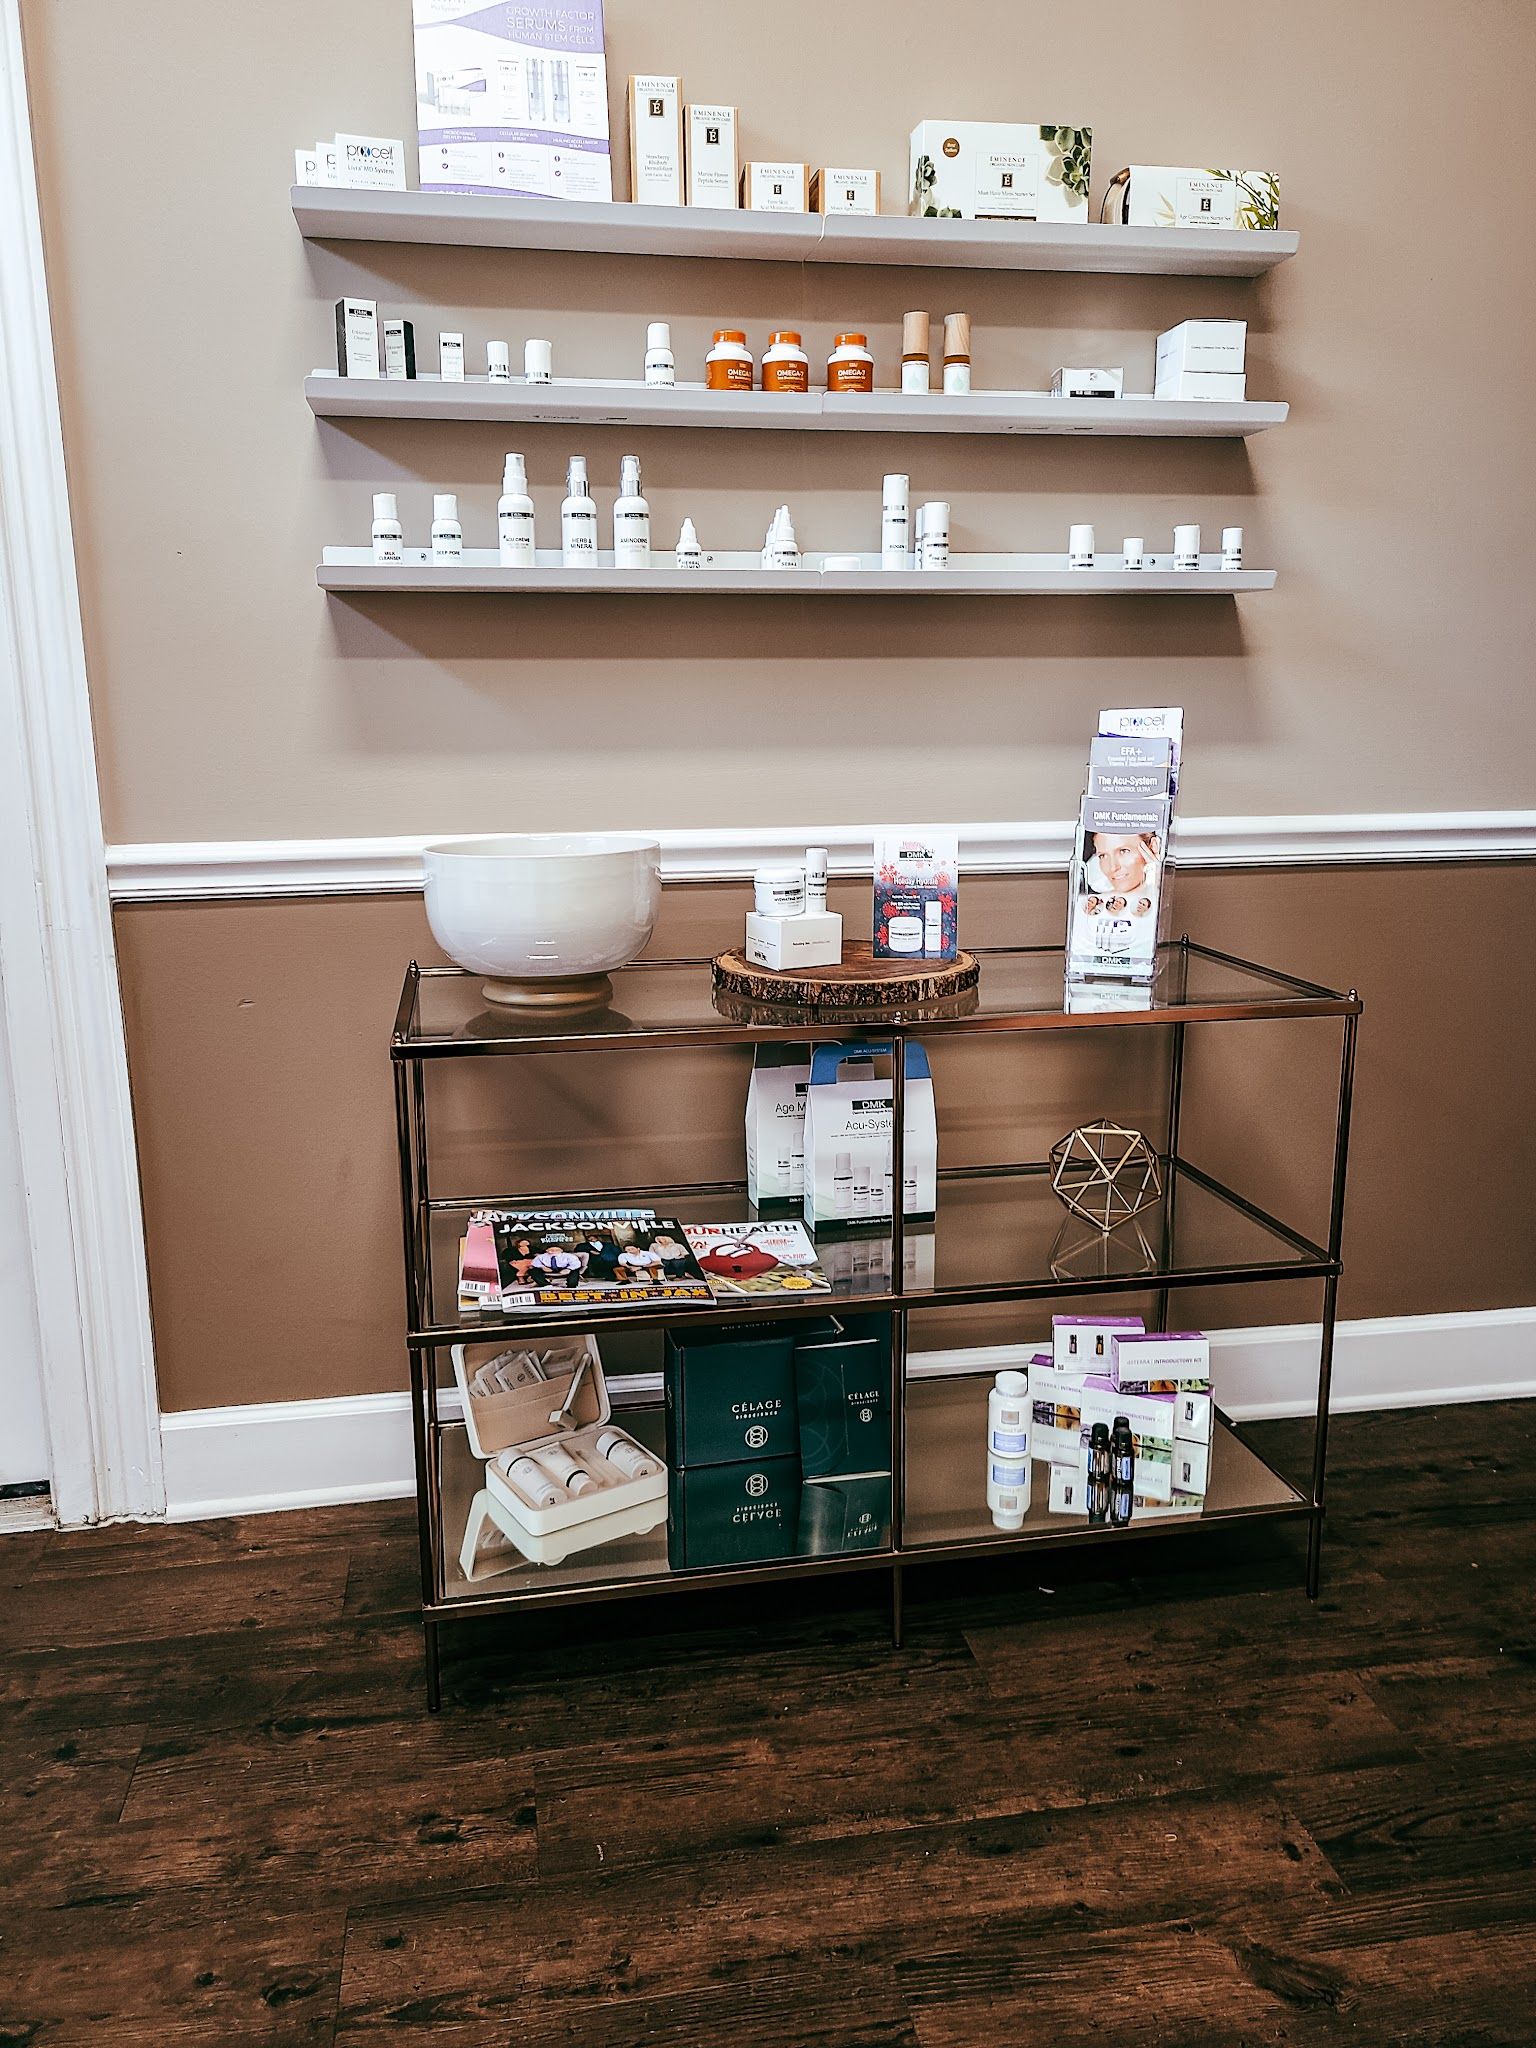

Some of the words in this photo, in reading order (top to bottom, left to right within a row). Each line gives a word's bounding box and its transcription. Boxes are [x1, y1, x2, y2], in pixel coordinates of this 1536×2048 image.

[555, 10, 595, 21] FACTOR
[507, 17, 565, 32] SERUMS
[508, 31, 542, 41] HUMAN
[569, 35, 595, 45] CELLS
[1098, 776, 1112, 785] The
[1113, 776, 1157, 787] Acu-System
[1094, 811, 1111, 820] DMK
[1112, 812, 1159, 822] Fundamentals
[1101, 956, 1123, 964] DMK
[775, 1102, 795, 1115] Age
[862, 1100, 886, 1109] DMK
[845, 1119, 893, 1130] Acu-Syste
[499, 1220, 676, 1234] JACKSONVILLE
[620, 1289, 648, 1299] IN
[662, 1288, 709, 1298] JAX
[848, 1391, 880, 1400] CÉLAGE
[731, 1400, 782, 1413] CÉLAGE
